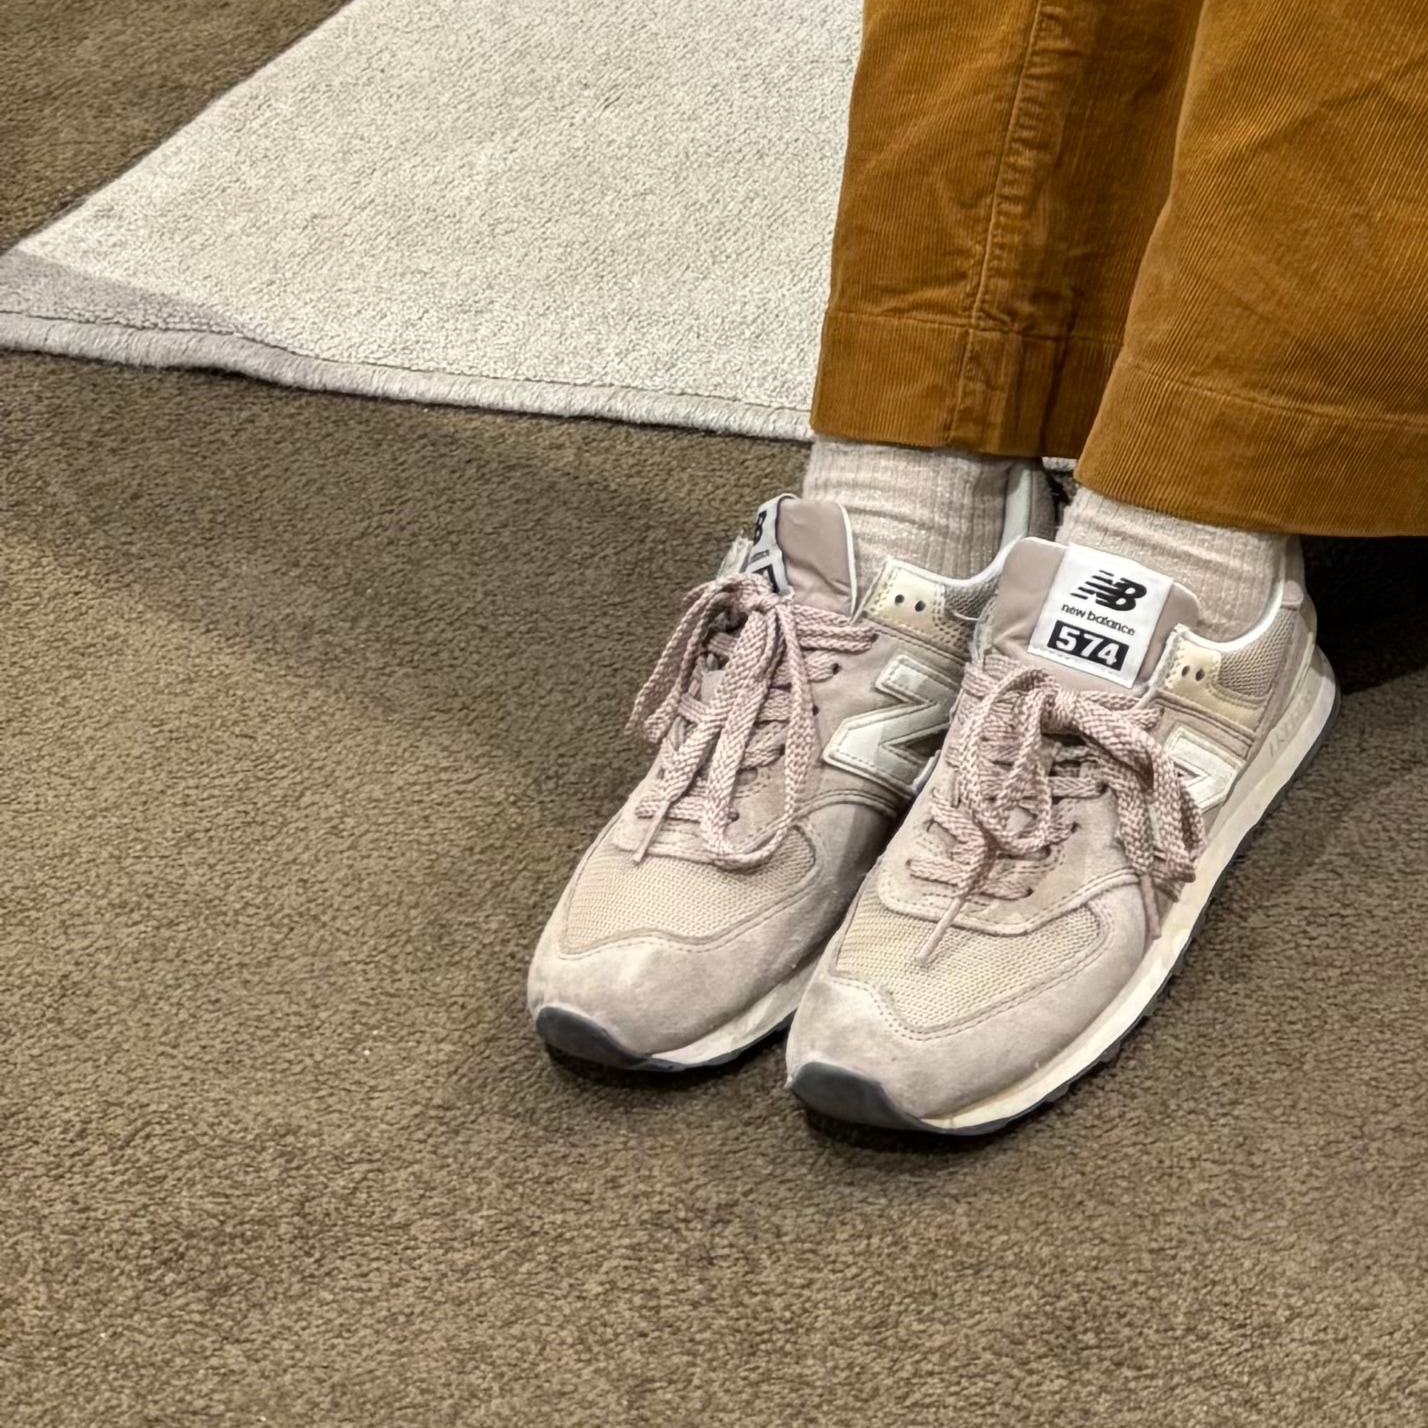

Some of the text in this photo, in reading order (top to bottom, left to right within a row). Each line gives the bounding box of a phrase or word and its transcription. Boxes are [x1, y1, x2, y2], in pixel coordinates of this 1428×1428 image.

[1061, 603, 1136, 636] new balance
[1055, 625, 1121, 666] 574
